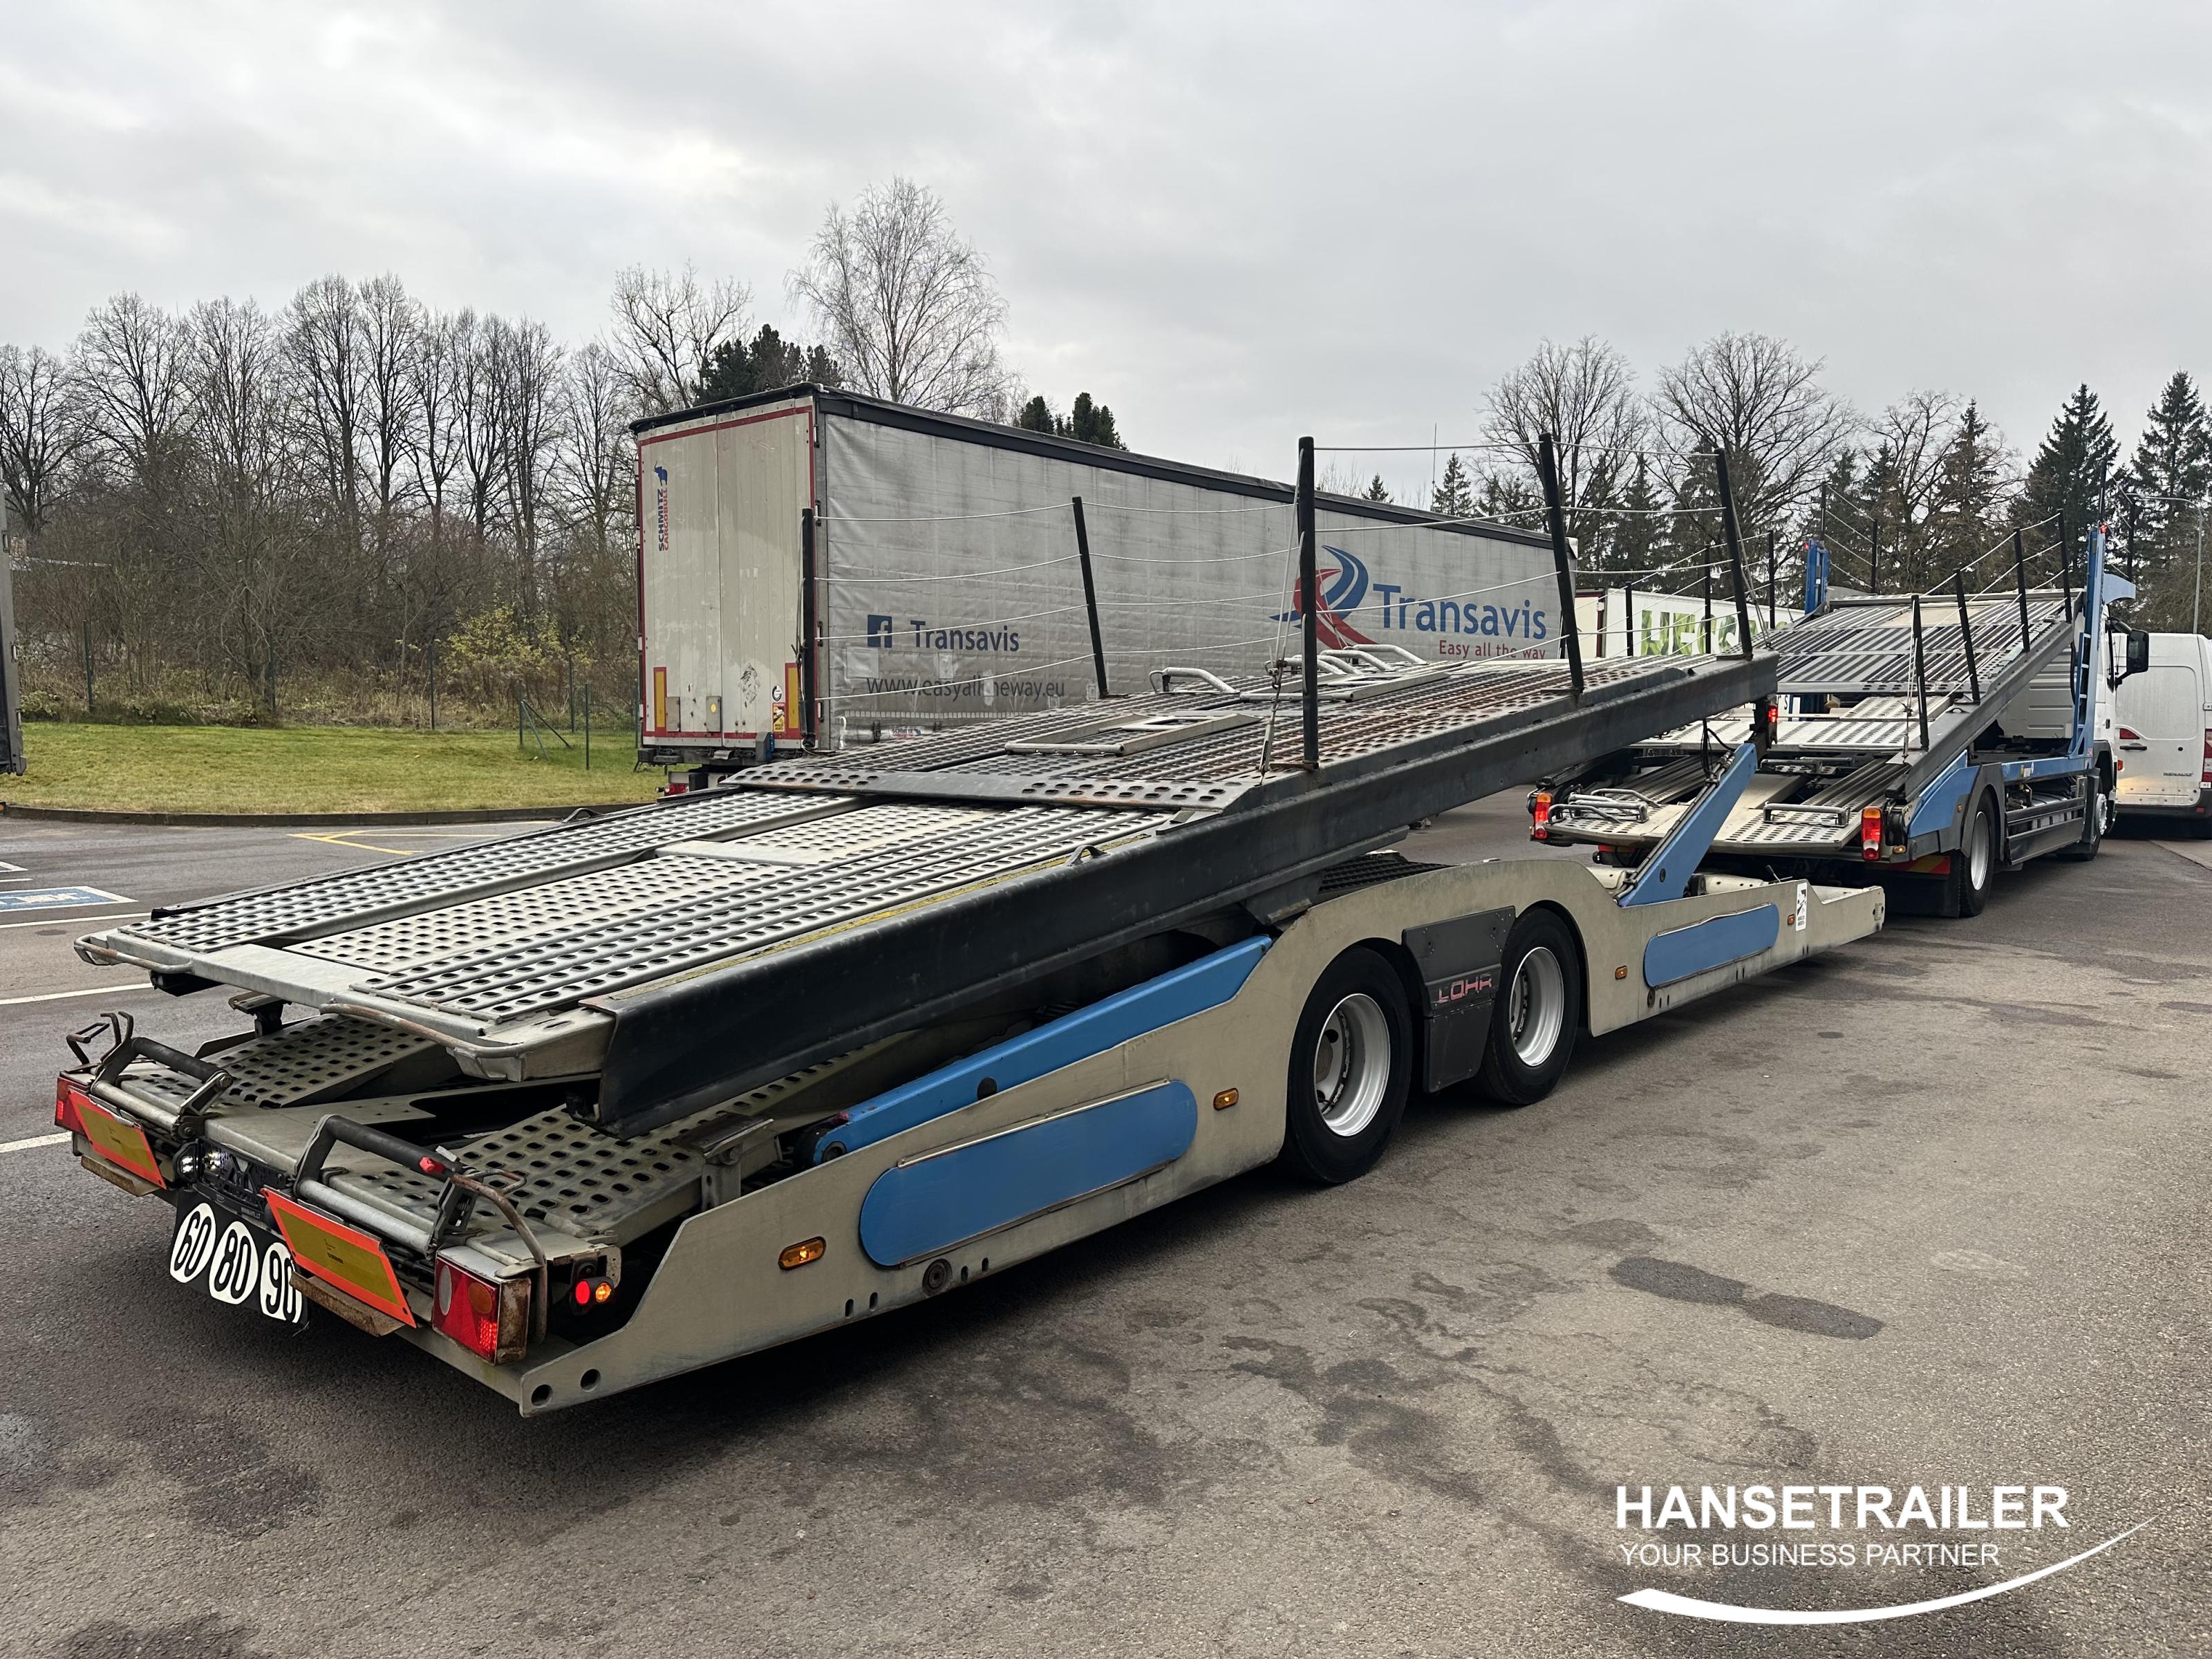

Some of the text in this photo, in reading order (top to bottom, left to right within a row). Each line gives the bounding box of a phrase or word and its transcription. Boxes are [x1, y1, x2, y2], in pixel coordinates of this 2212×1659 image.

[1373, 583, 1547, 639] Transavis
[910, 619, 1020, 652] Transavis
[1439, 640, 1546, 660] Easy all the way
[866, 675, 1065, 702] www.easyalleway.eu
[1437, 972, 1493, 1004] LOHR
[174, 1210, 212, 1278] 60
[214, 1228, 252, 1300] 80
[265, 1249, 297, 1323] 90
